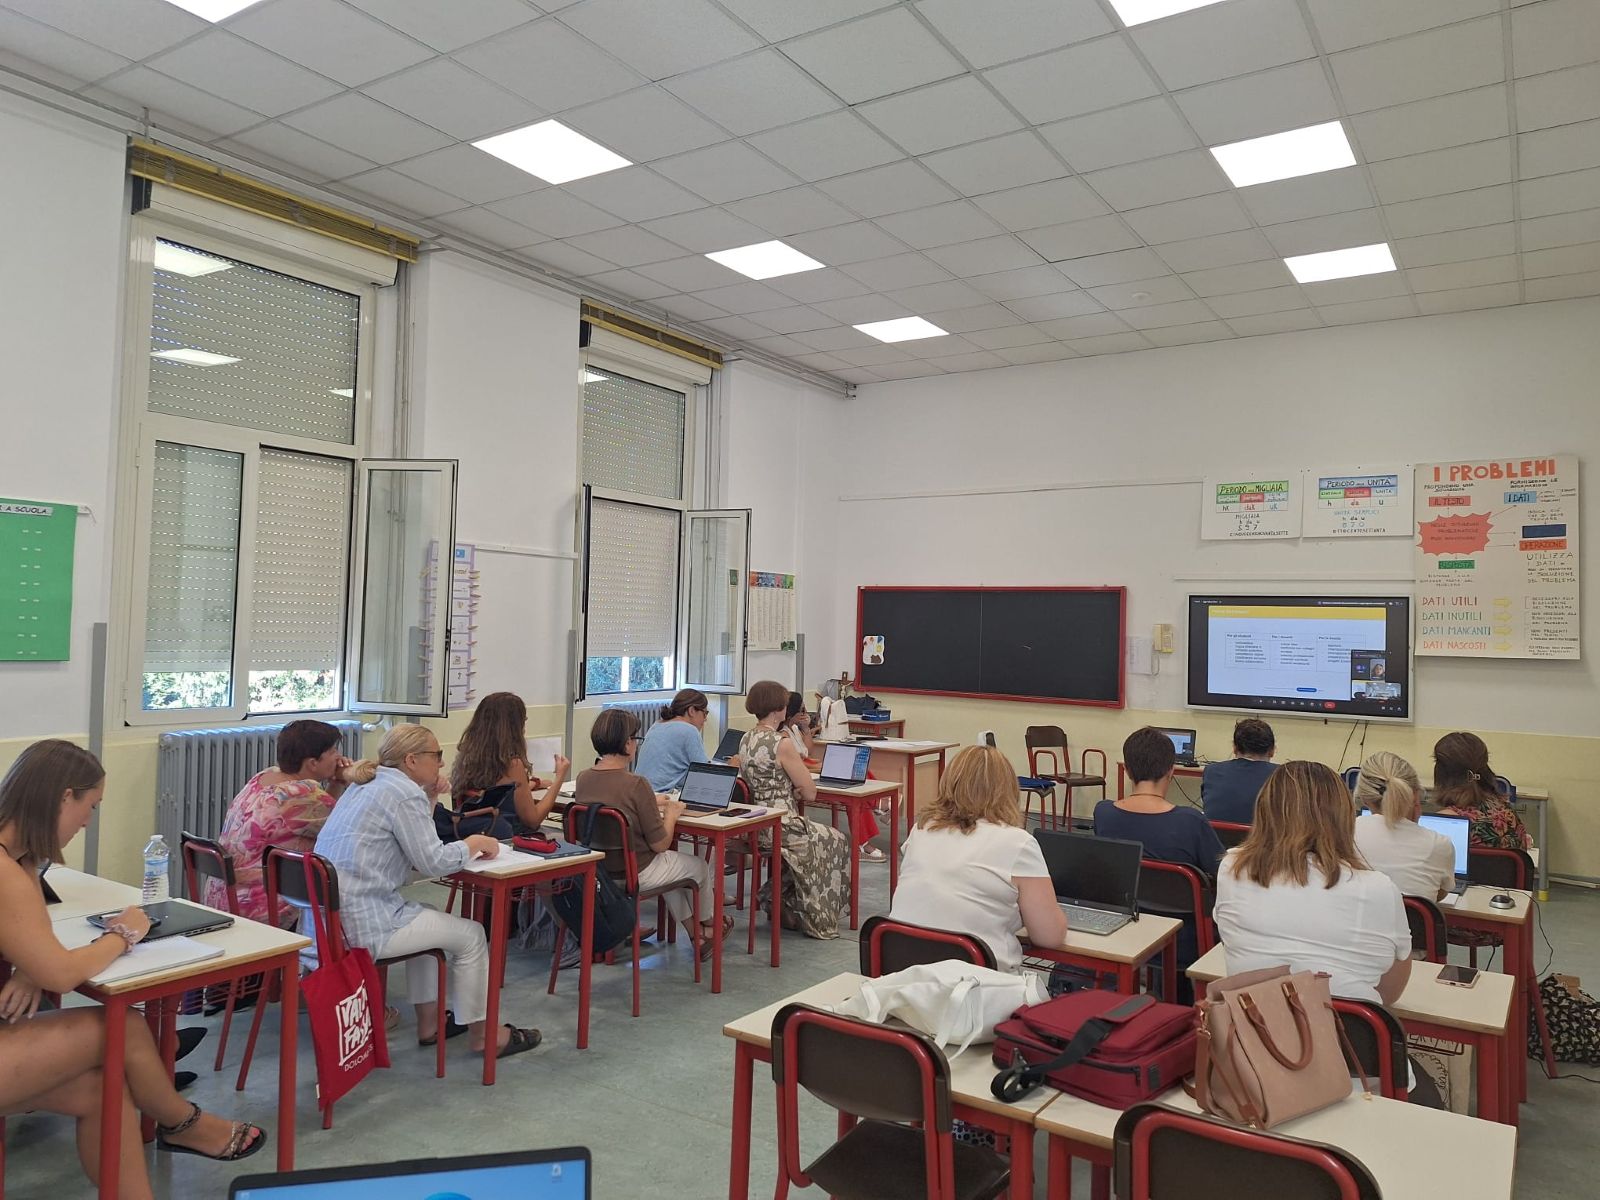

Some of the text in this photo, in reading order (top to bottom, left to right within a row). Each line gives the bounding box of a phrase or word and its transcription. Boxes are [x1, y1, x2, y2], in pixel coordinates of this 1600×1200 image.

[1434, 459, 1555, 482] I PROBLEMI
[1255, 483, 1284, 492] MIGLIAIA
[1327, 480, 1355, 489] PERIODO
[1367, 477, 1392, 485] UNITÀ
[1513, 493, 1530, 502] DATI
[15, 506, 47, 514] SCUOLA
[1527, 552, 1573, 561] UTILIZZA
[1422, 596, 1477, 606] DATI UTILI
[1422, 611, 1482, 621] DATI INUTILI
[1422, 626, 1491, 636] DATI MANCANTI
[1423, 641, 1486, 650] DATI NASCOSTI
